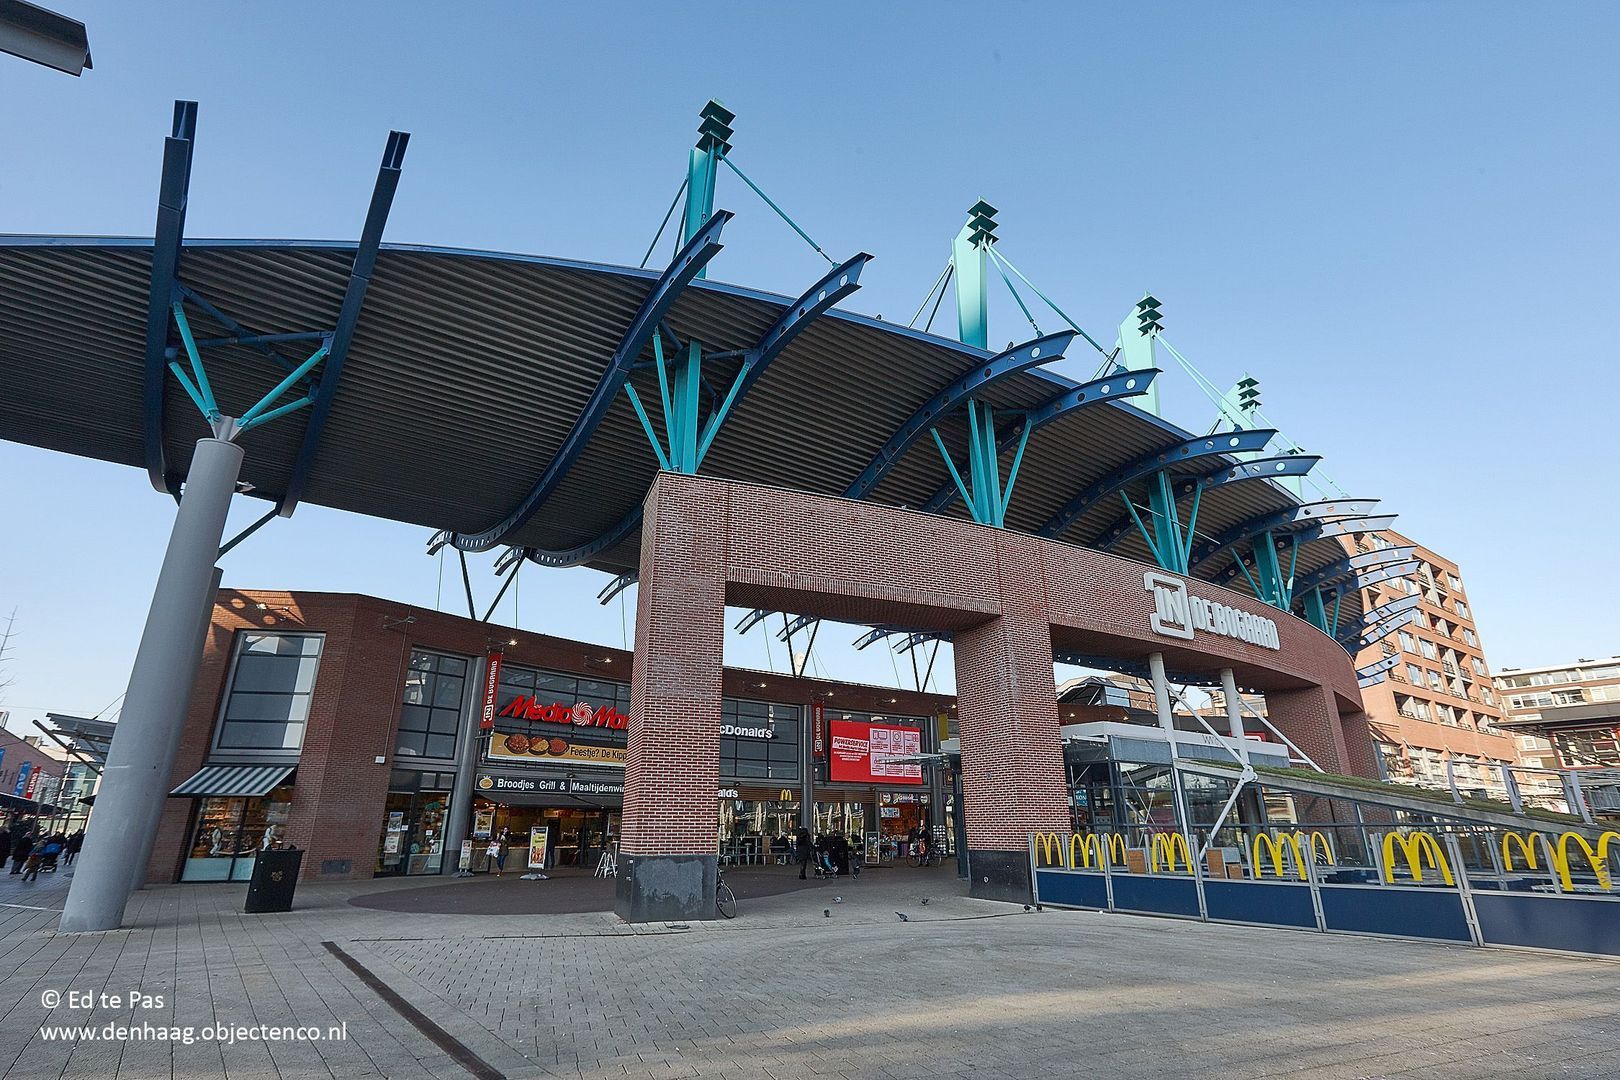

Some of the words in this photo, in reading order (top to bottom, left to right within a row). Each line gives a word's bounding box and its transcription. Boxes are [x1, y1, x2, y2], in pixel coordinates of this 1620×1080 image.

[499, 694, 573, 724] Media
[570, 746, 600, 759] Feestje?
[601, 749, 611, 758] De
[497, 778, 535, 791] Broodjes
[539, 780, 556, 791] Grill
[559, 781, 566, 791] &
